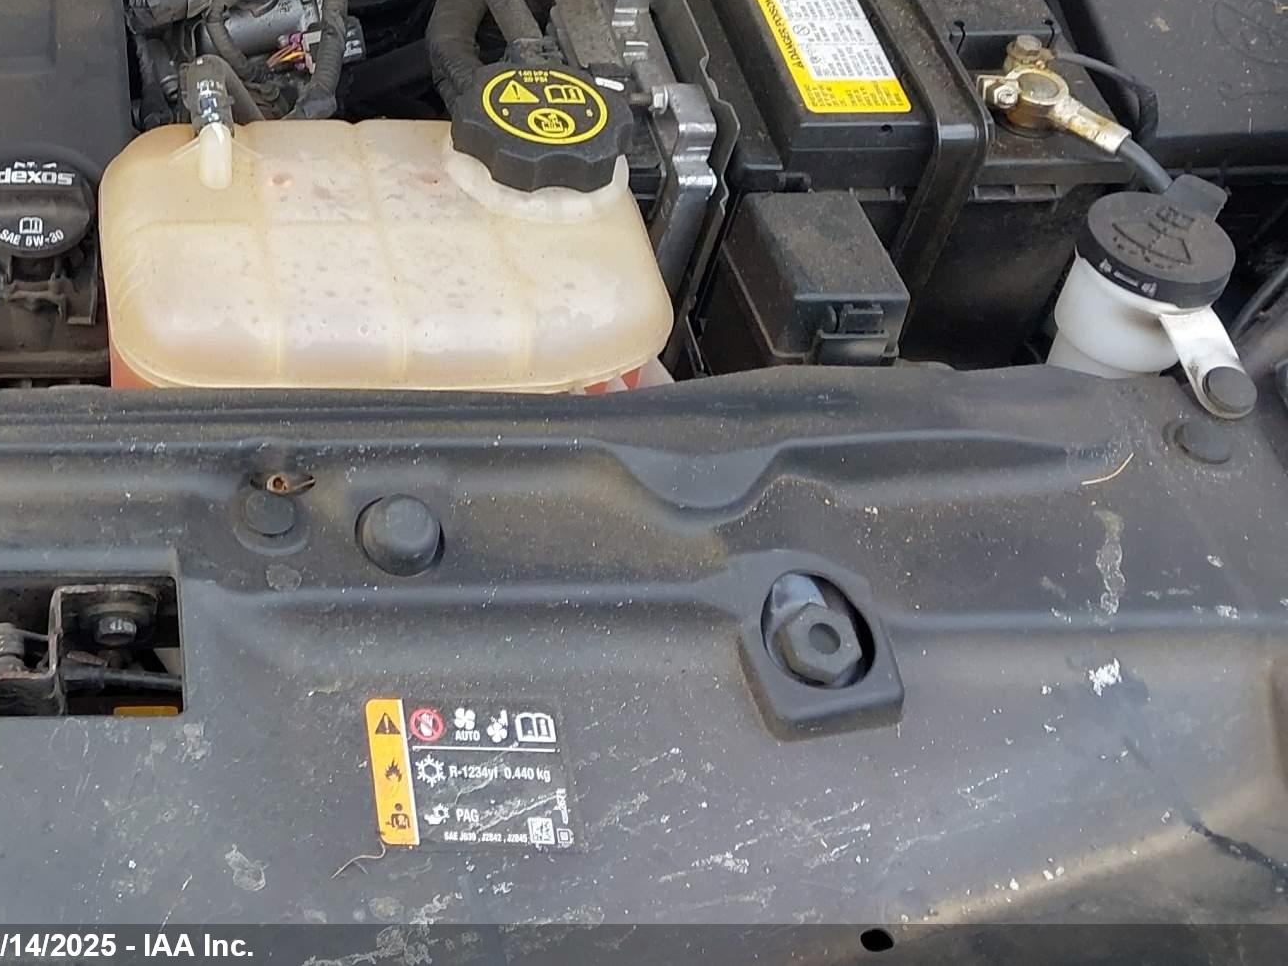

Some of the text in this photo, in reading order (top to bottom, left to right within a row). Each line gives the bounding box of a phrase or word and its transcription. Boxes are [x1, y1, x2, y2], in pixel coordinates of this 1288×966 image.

[0, 229, 21, 246] SAE
[455, 730, 480, 741] AUTO
[448, 765, 551, 783] R-1234yf 0.440 kg
[456, 808, 480, 822] PAG
